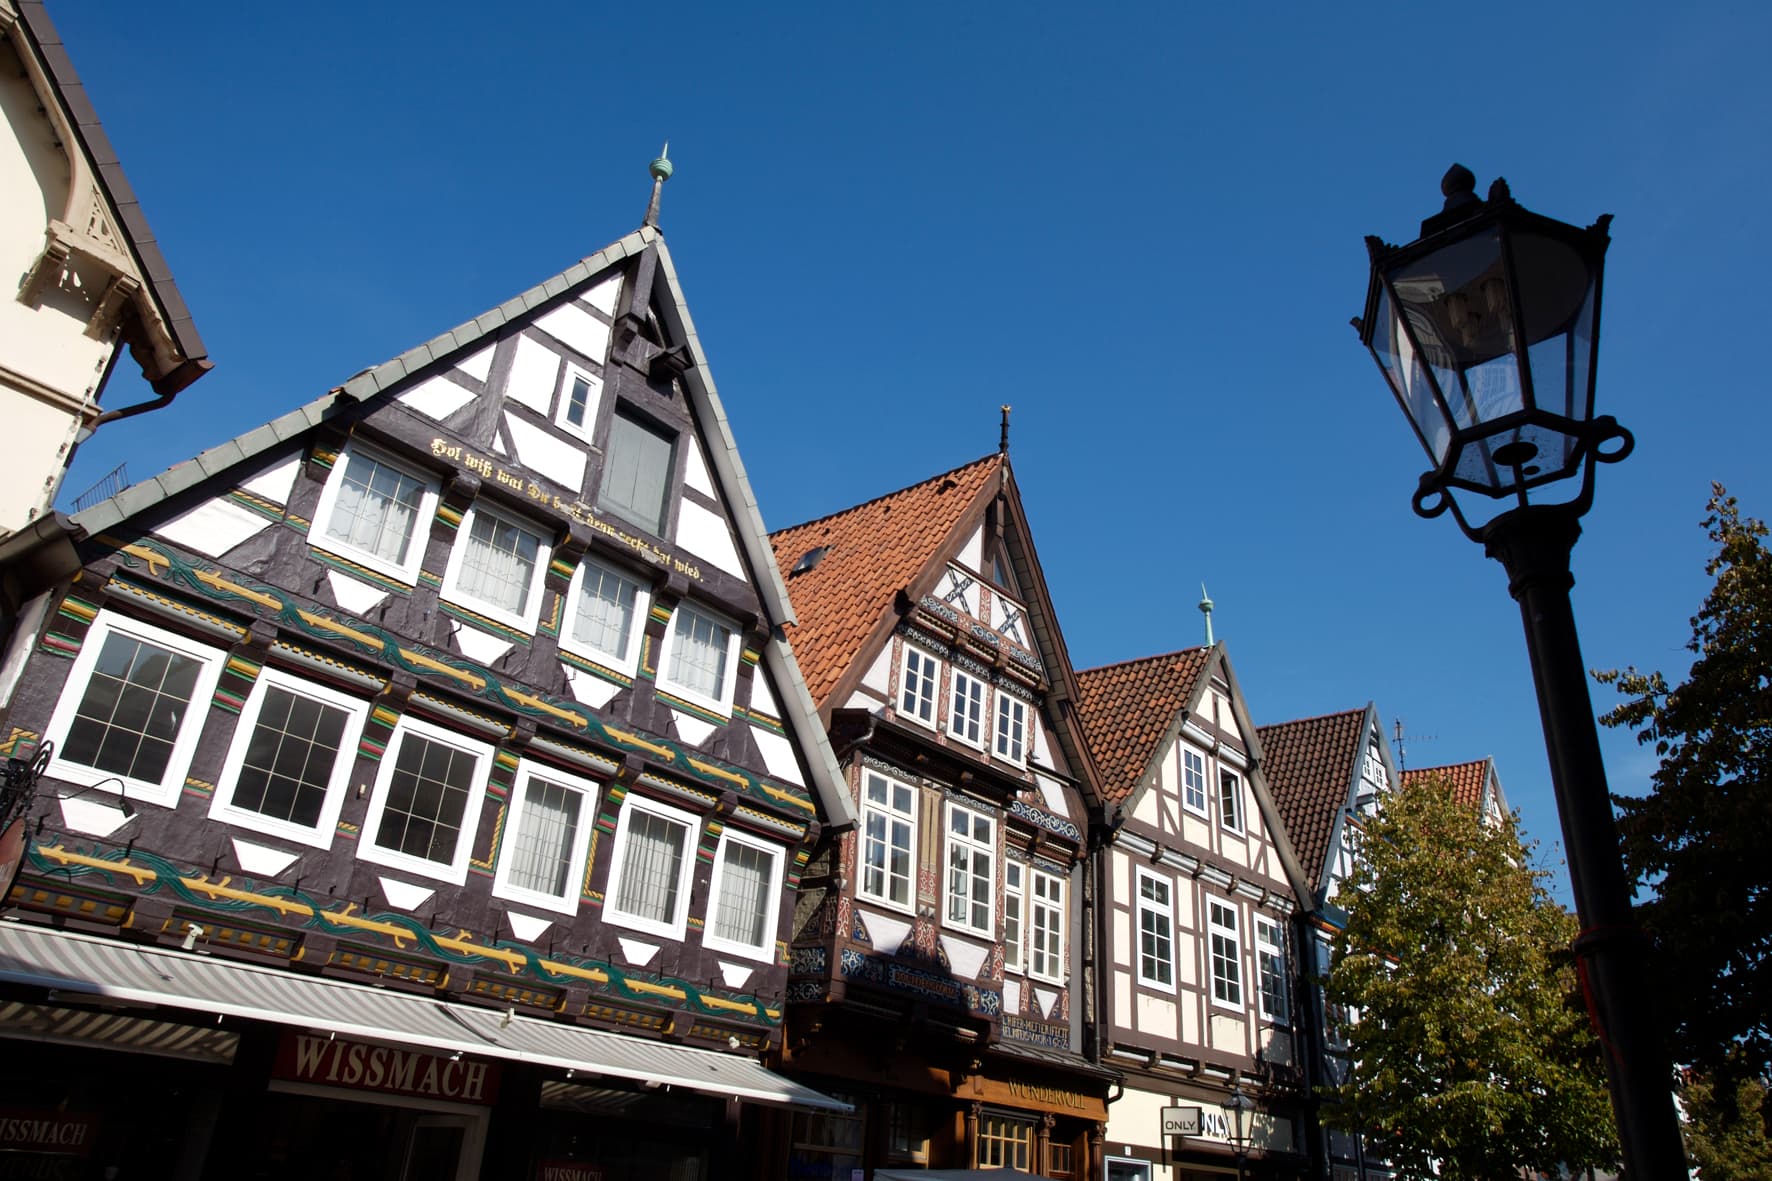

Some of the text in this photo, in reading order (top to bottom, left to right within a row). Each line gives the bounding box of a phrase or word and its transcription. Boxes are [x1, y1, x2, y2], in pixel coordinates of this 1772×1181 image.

[296, 1034, 489, 1101] WISSMACH
[1008, 1077, 1088, 1110] WUNDERVOLL
[1165, 1120, 1195, 1130] ONLY
